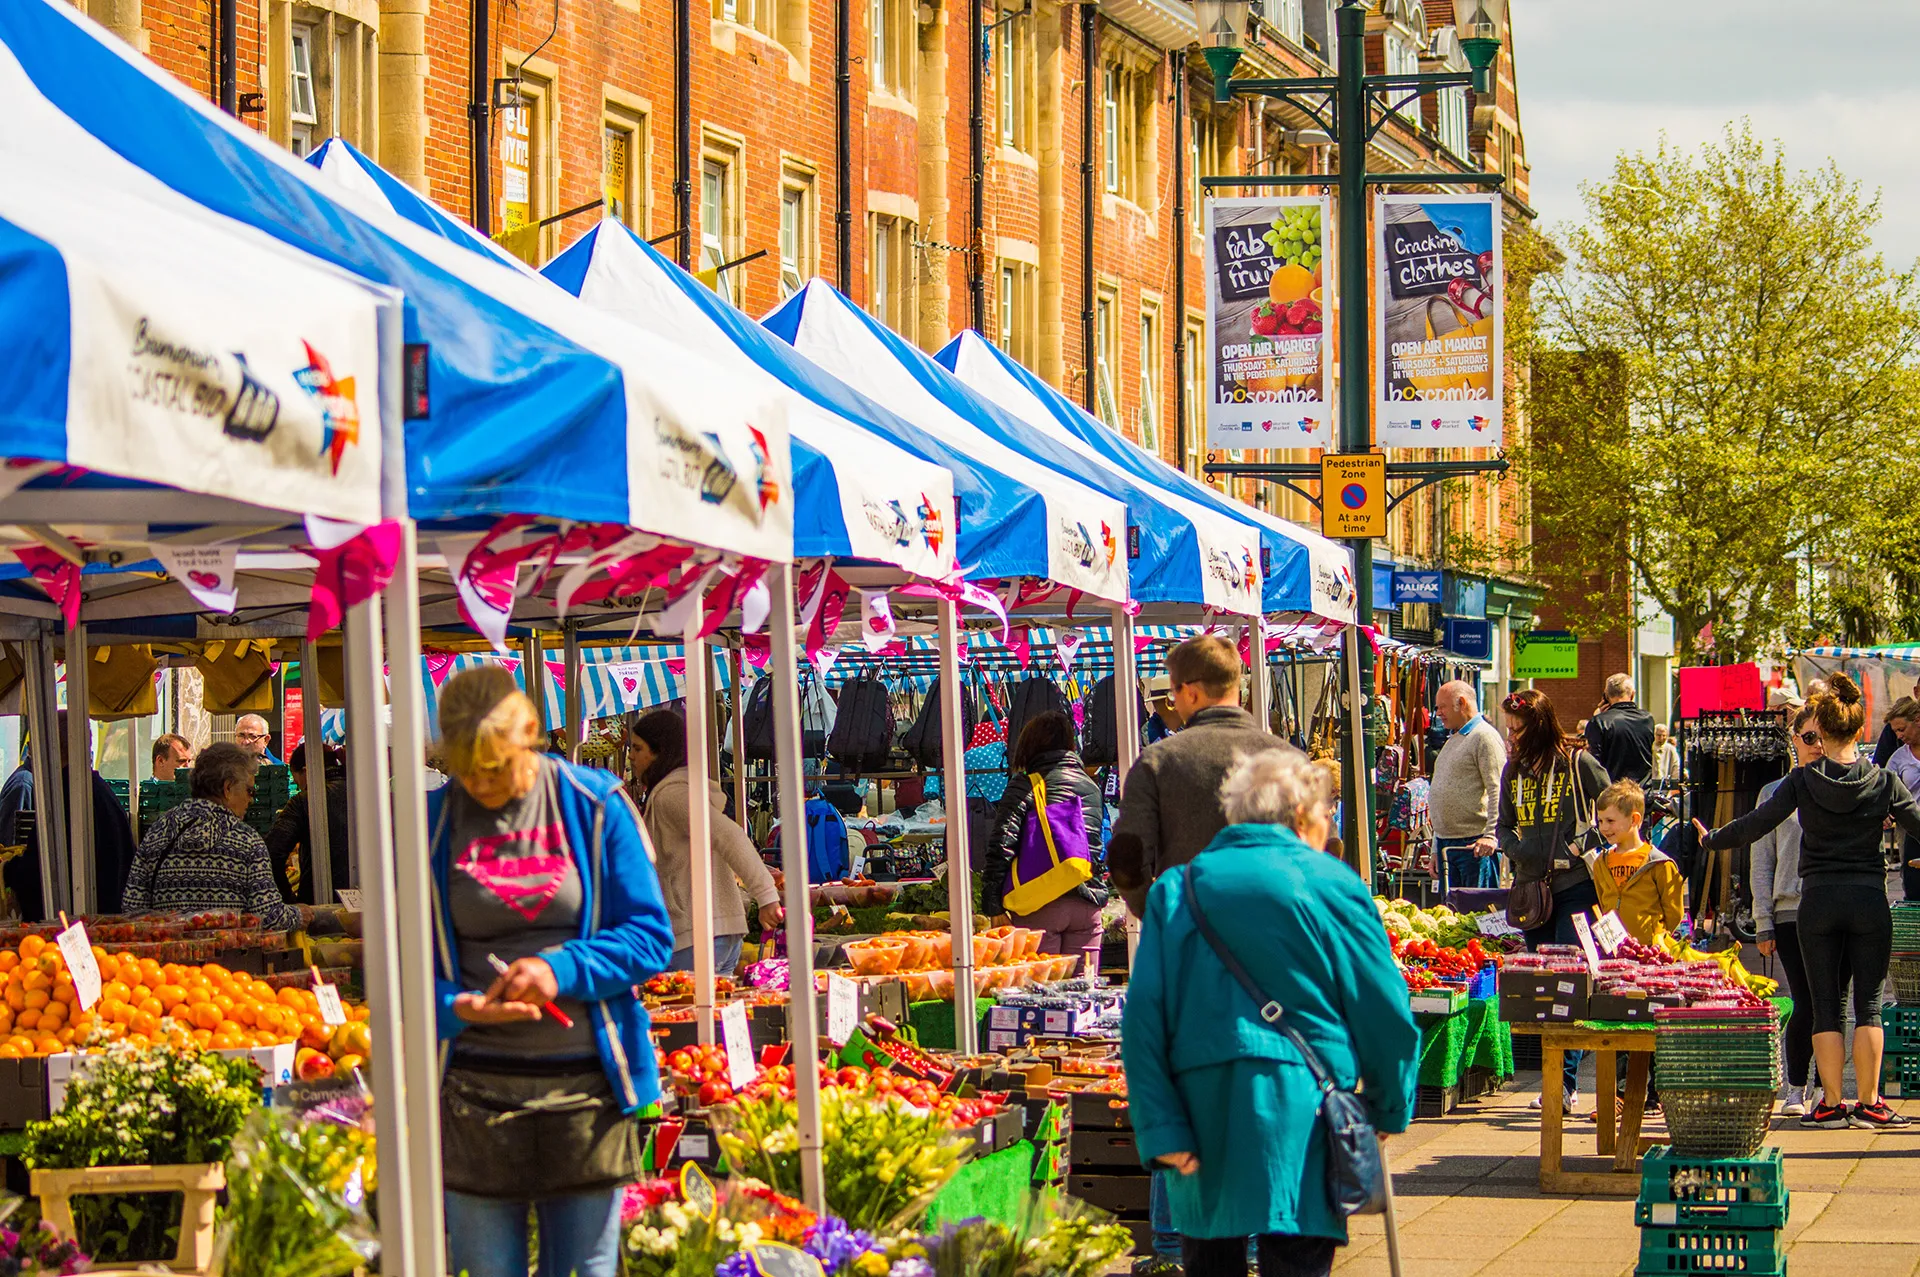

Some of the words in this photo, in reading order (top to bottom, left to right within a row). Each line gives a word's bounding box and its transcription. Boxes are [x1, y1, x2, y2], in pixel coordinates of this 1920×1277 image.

[1395, 234, 1459, 255] Cracking
[1229, 256, 1280, 288] fruit
[1400, 253, 1476, 284] clothes
[1222, 344, 1252, 359] OPEN
[1254, 342, 1272, 356] AIR
[1275, 338, 1317, 354] MARKET
[1392, 341, 1422, 356] OPEN
[1424, 340, 1442, 354] AIR
[1445, 336, 1487, 352] MARKET
[1223, 360, 1266, 373] THURSDAYS
[1275, 356, 1318, 368] SATURDAYS
[1392, 358, 1436, 370] THURSDAYS
[1446, 354, 1488, 366] SATURDAYS
[1224, 373, 1231, 381] IN
[1233, 372, 1245, 380] THE
[1247, 368, 1286, 379] PEDESTRIAN
[1288, 365, 1317, 375] PRECINCT
[1393, 371, 1400, 379] IN
[1402, 370, 1414, 378] THE
[1416, 366, 1456, 377] PEDESTRIAN
[1458, 364, 1488, 373] PRECINCT
[1220, 384, 1318, 404] boscombe
[1389, 382, 1488, 402] boscombe
[1327, 459, 1380, 468] Pedestrian
[1341, 470, 1366, 478] Zone
[1344, 524, 1366, 532] time
[1517, 802, 1536, 820] NY
